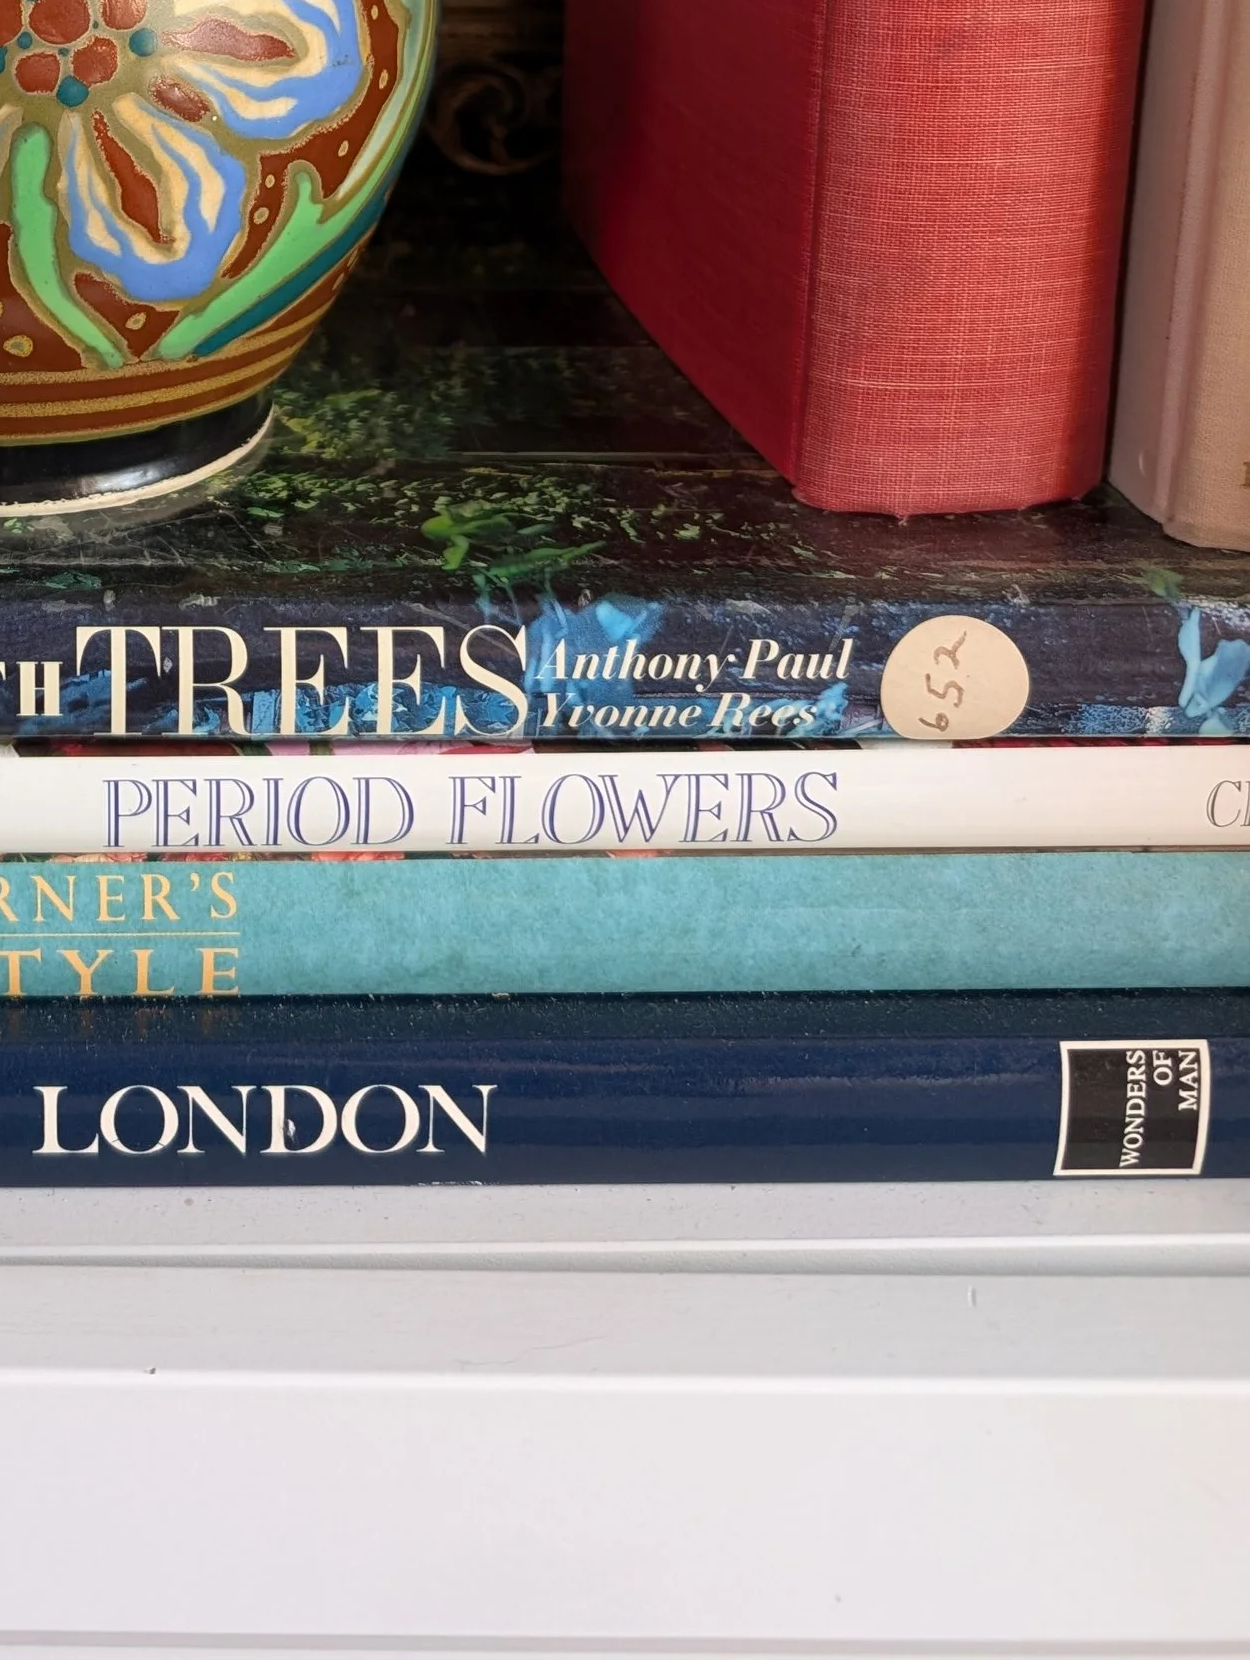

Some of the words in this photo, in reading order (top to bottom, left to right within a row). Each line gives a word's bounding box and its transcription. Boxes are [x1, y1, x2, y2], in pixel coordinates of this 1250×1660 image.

[75, 624, 529, 737] TREES
[534, 637, 734, 694] Anthony
[742, 639, 853, 679] Paul
[918, 630, 967, 732] 652
[539, 692, 701, 729] Yvonne
[707, 692, 818, 728] Rees
[102, 776, 415, 847] PERIOD
[445, 771, 839, 845] FLOWERS
[1152, 1050, 1173, 1086] OF
[1178, 1050, 1199, 1111] MAN
[31, 1084, 498, 1155] LONDON
[1119, 1049, 1147, 1168] WONDERS
